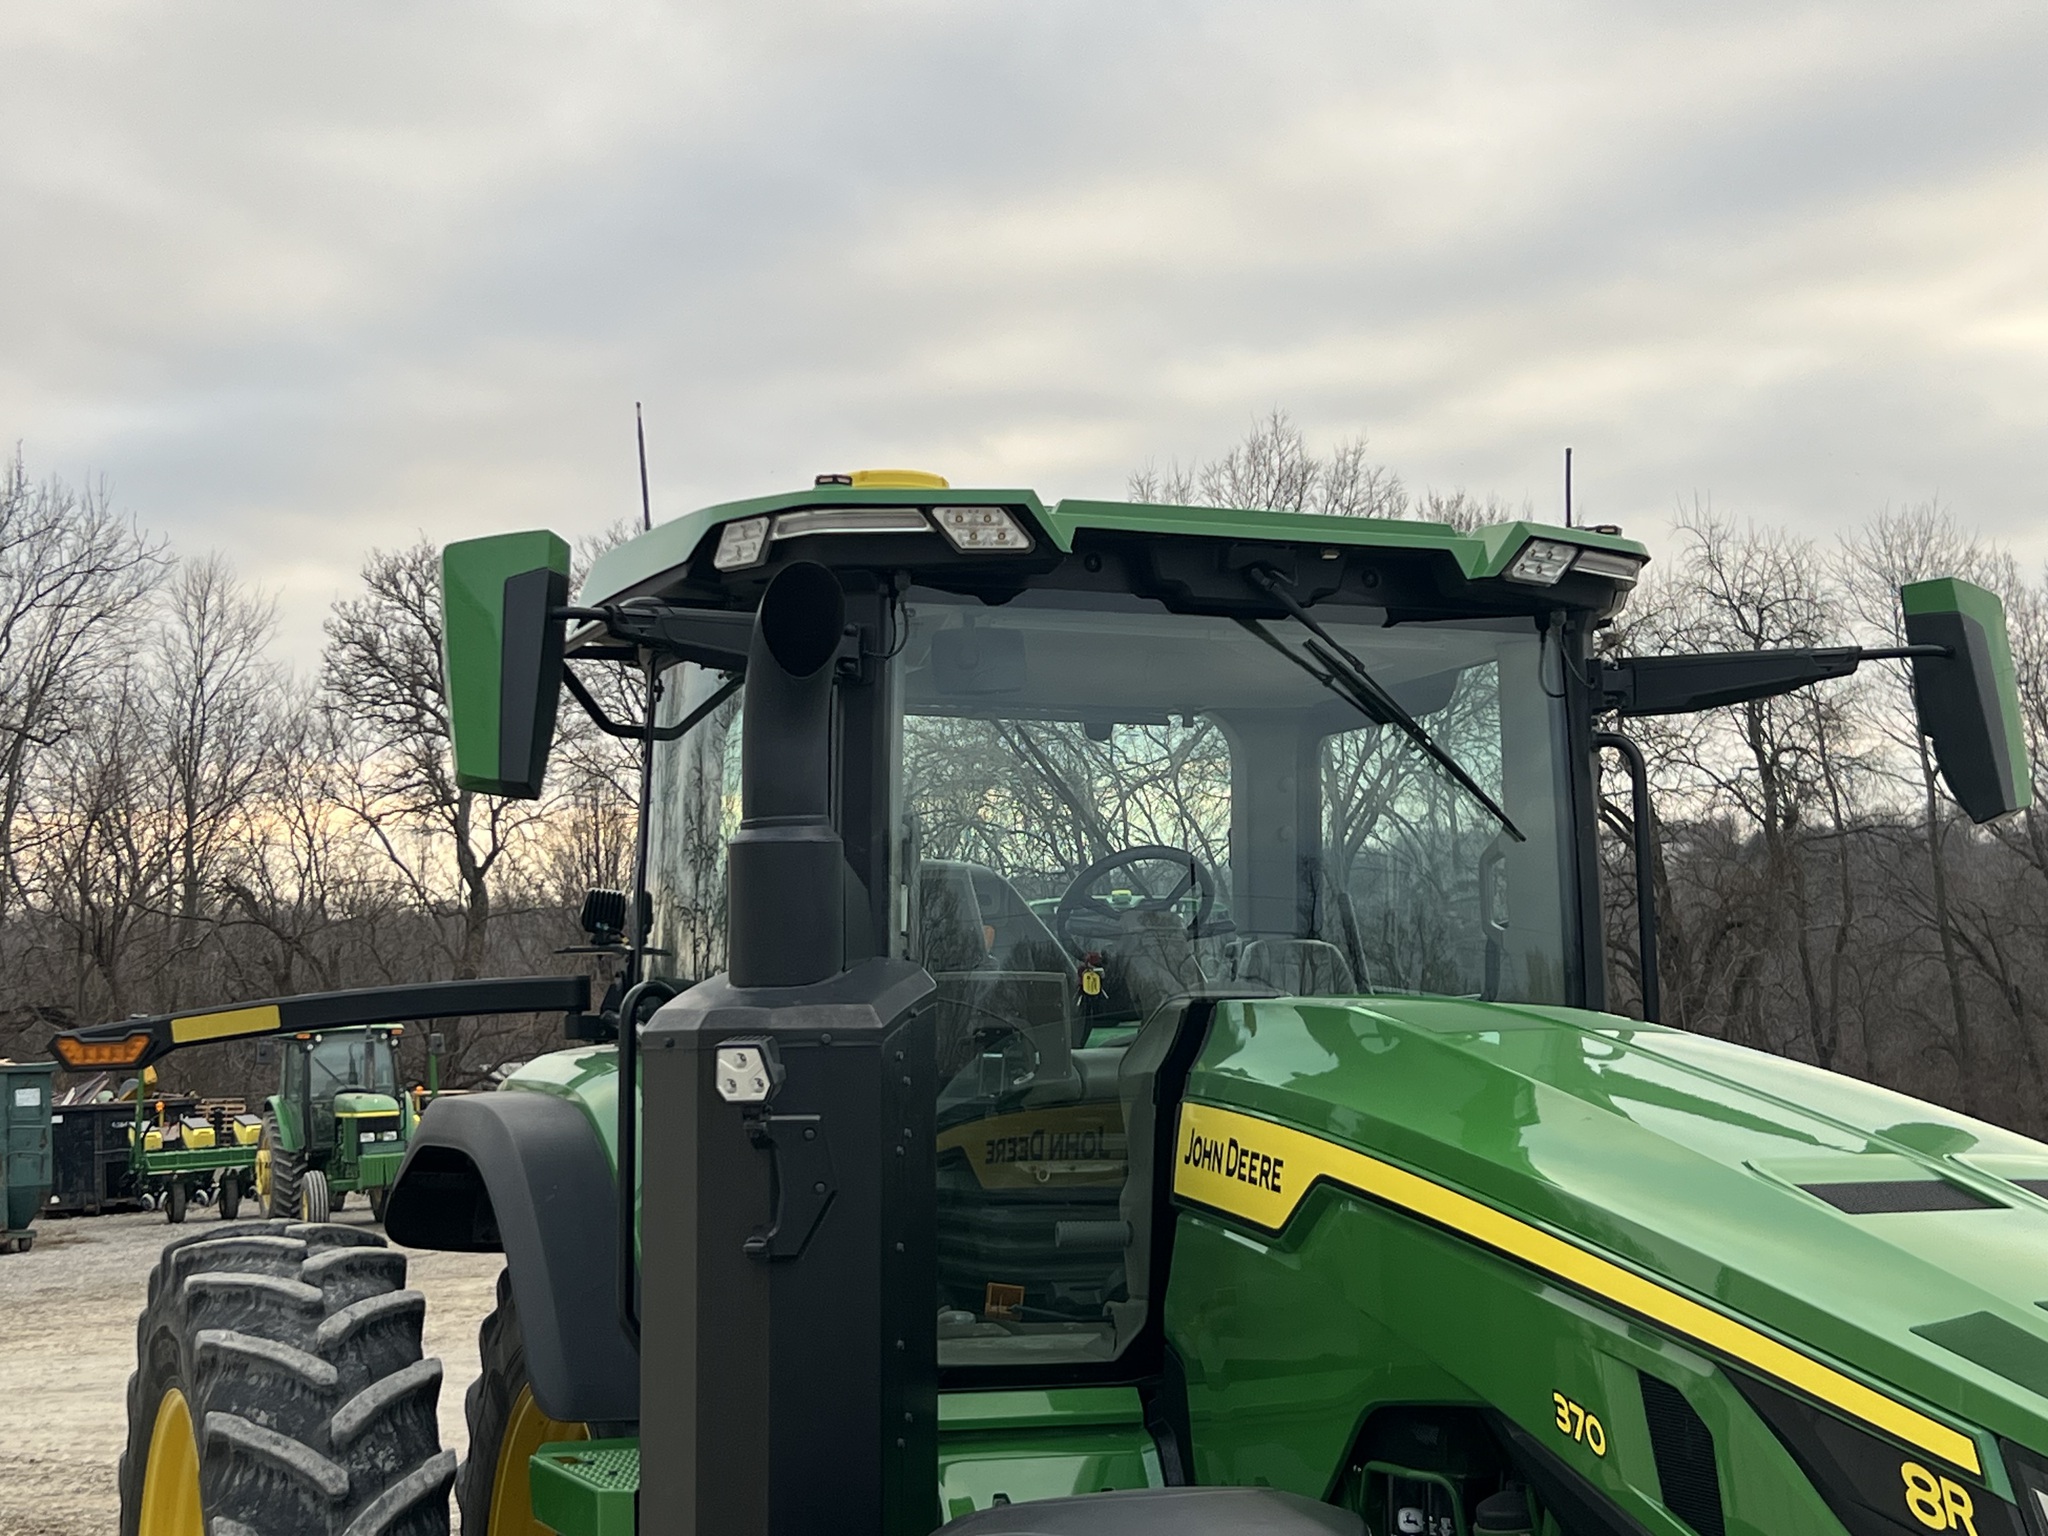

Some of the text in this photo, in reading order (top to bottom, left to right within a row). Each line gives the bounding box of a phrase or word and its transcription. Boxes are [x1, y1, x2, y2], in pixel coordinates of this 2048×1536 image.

[1184, 1128, 1284, 1194] JOHN DEERE
[1552, 1391, 1606, 1457] 370
[1900, 1460, 1979, 1536] 8R
